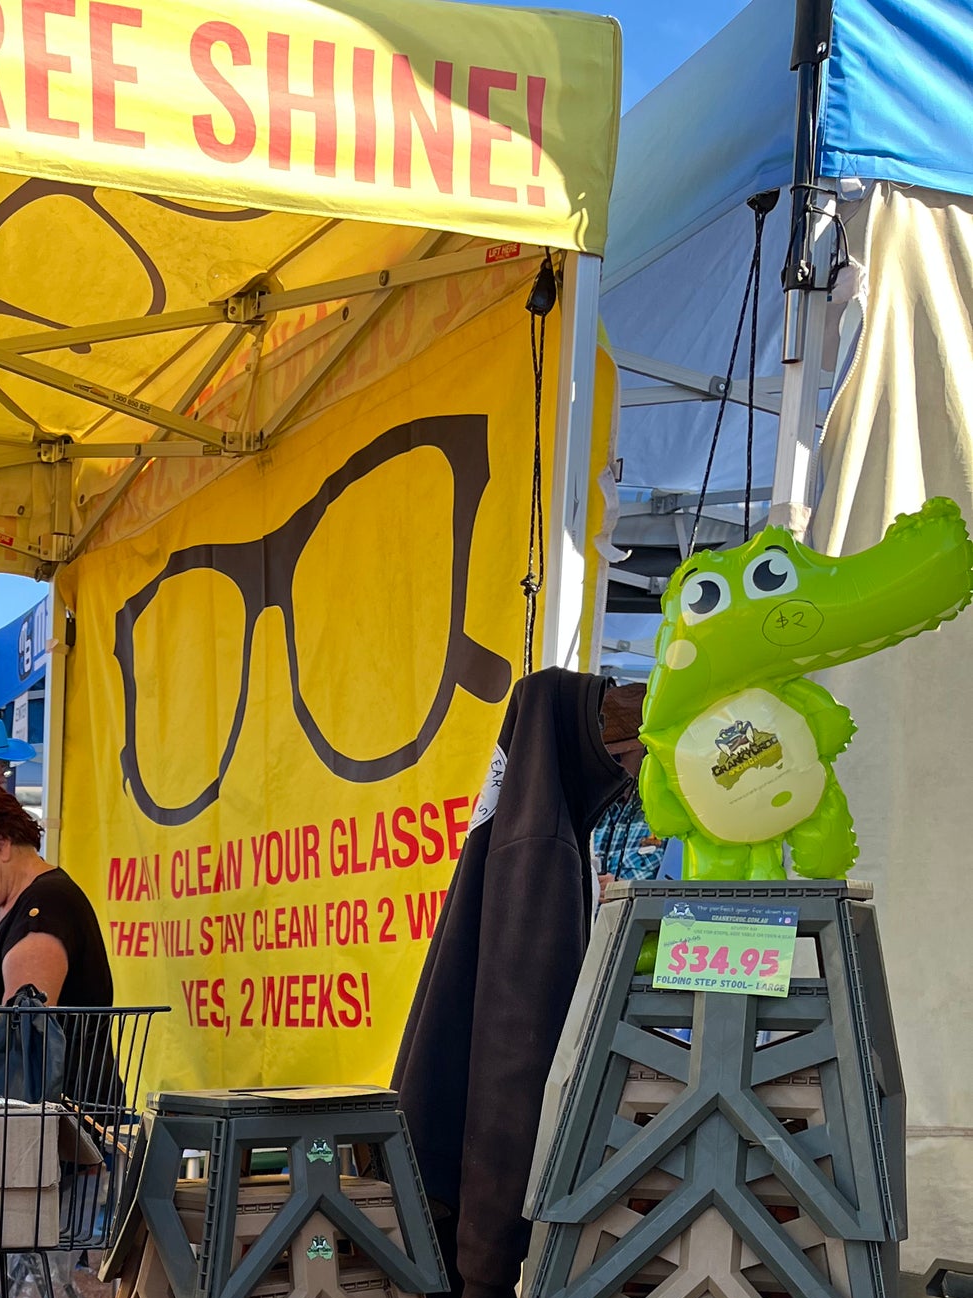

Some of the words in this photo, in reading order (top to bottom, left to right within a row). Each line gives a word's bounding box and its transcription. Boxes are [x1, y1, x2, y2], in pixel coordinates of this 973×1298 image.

[190, 21, 547, 207] SHINE!
[775, 610, 808, 630] $2
[490, 759, 503, 788] EAR
[171, 839, 243, 900] CLEAN
[251, 824, 320, 886] YOUR
[330, 793, 481, 877] GLASSE
[109, 920, 159, 958] THEY
[199, 912, 246, 956] STAY
[253, 904, 317, 951] CLEAN
[325, 899, 369, 946] FOR
[377, 897, 397, 943] 2
[668, 941, 780, 977] $34.95
[181, 978, 231, 1037] YES,
[240, 978, 255, 1027] 2
[261, 972, 372, 1028] WEEKS!
[656, 976, 691, 985] FOLDING
[694, 979, 717, 987] STEP
[756, 983, 786, 992] LARGE
